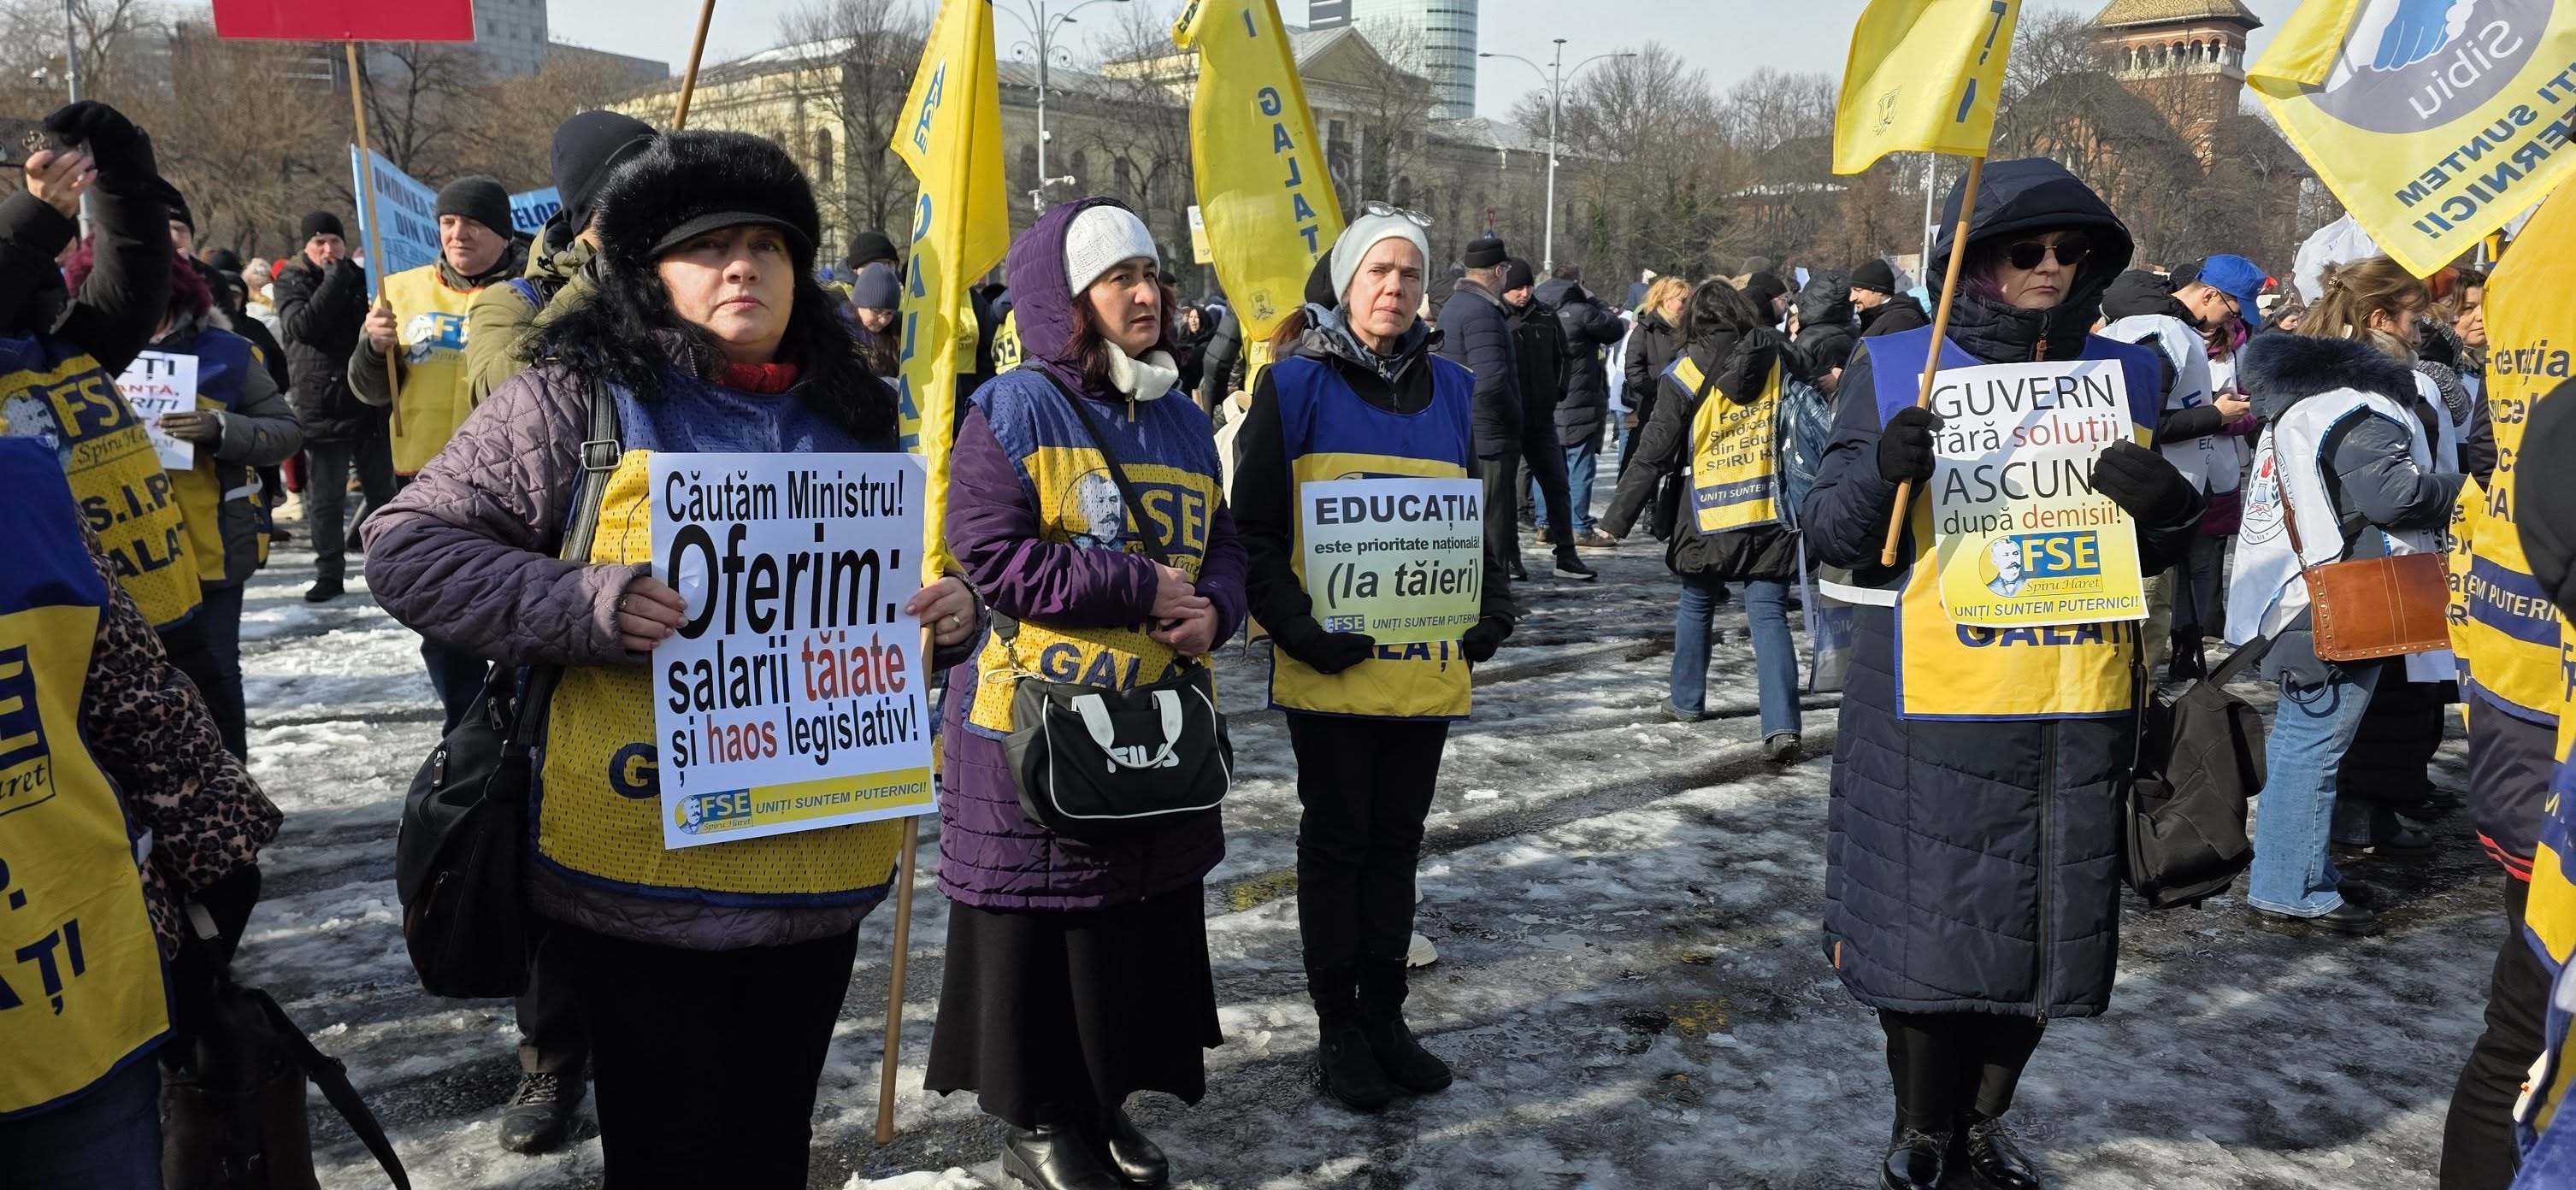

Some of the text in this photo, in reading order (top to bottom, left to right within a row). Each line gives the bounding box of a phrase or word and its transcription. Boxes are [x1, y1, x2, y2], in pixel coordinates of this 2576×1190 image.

[48, 376, 120, 438] FS
[1720, 400, 1775, 424] Federa
[1931, 374, 2116, 420] GUVERN
[1711, 443, 1735, 457] din
[1931, 421, 2001, 455] fără
[666, 469, 904, 522] Căutăm Ministru!
[1942, 457, 2093, 506] ASCUN
[1315, 494, 1480, 532] EDUCAȚIA
[1943, 501, 2121, 539] după demisii!
[1314, 535, 1481, 556] este prioritate națională!
[2021, 536, 2099, 572] FSE
[668, 522, 900, 639] Oferim:
[1326, 557, 1479, 610] (la tăieri)
[2025, 577, 2100, 595] Spiru Haret
[1333, 616, 1365, 632] FSE
[1372, 619, 1402, 633] UNIȚI
[1404, 616, 1447, 628] SUNTEM
[1954, 596, 2139, 621] UNIȚI SUNTEM PUTERNICI!
[668, 630, 905, 715] salarii tăiate
[672, 716, 698, 787] și
[705, 714, 778, 764] haos
[786, 694, 919, 766] legislativ!
[701, 792, 750, 818] FSE
[756, 782, 927, 815] UNIȚI SUNTEM PUTERNICI!
